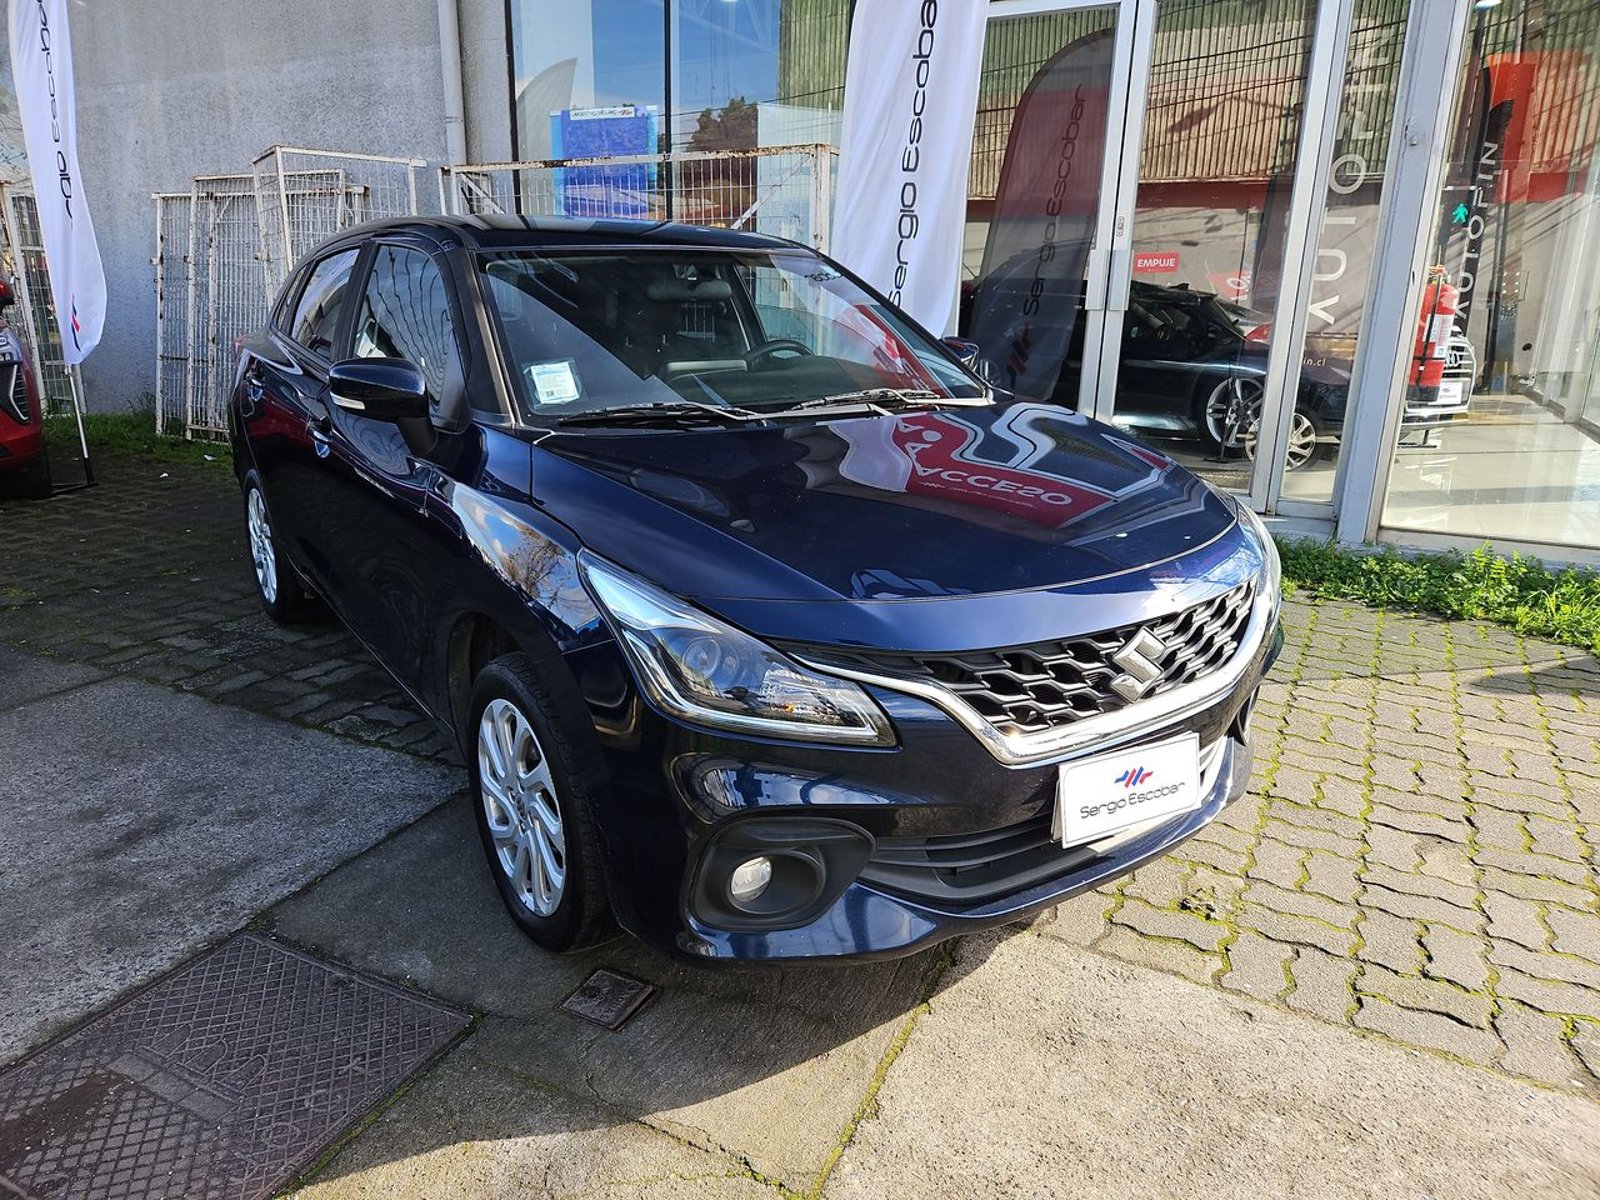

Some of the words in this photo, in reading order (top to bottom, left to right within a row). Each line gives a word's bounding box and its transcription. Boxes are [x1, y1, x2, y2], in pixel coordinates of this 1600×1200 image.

[37, 0, 60, 143] Escoba
[887, 182, 919, 307] Sergio
[1024, 217, 1058, 317] Sergio
[1046, 83, 1084, 217] Escobar
[1137, 258, 1176, 268] EMPUJE
[1080, 798, 1126, 819] Sergio
[1128, 782, 1185, 805] Escobar
